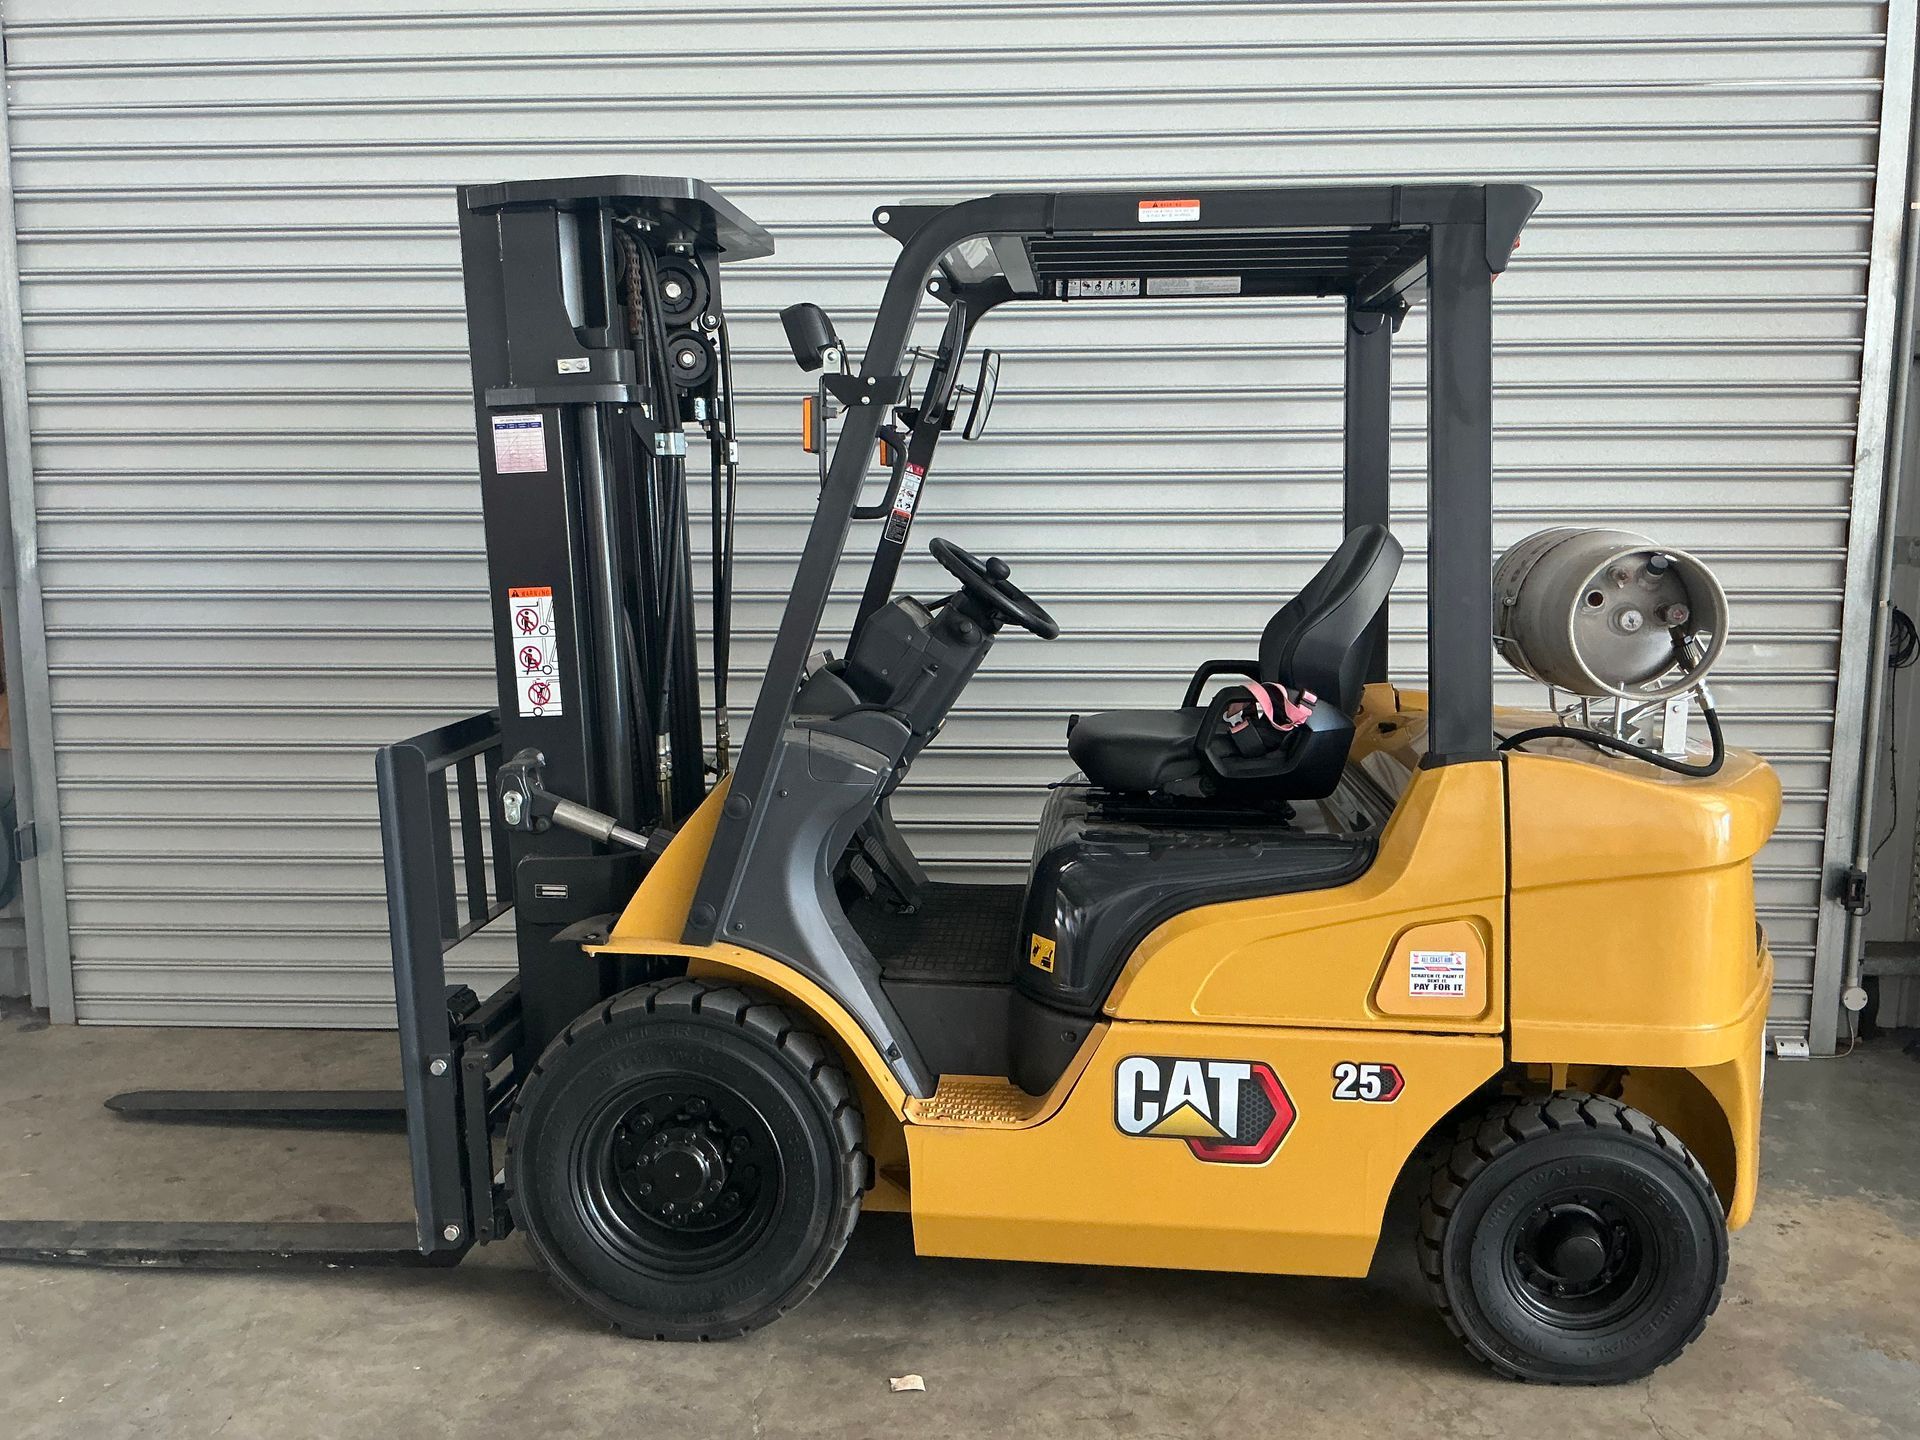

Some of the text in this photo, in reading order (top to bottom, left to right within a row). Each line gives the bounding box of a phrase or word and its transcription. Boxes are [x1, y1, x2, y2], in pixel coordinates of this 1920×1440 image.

[521, 589, 550, 598] WARNING
[1433, 983, 1450, 991] FOR
[1335, 1064, 1382, 1099] 25
[1117, 1057, 1251, 1138] CAT
